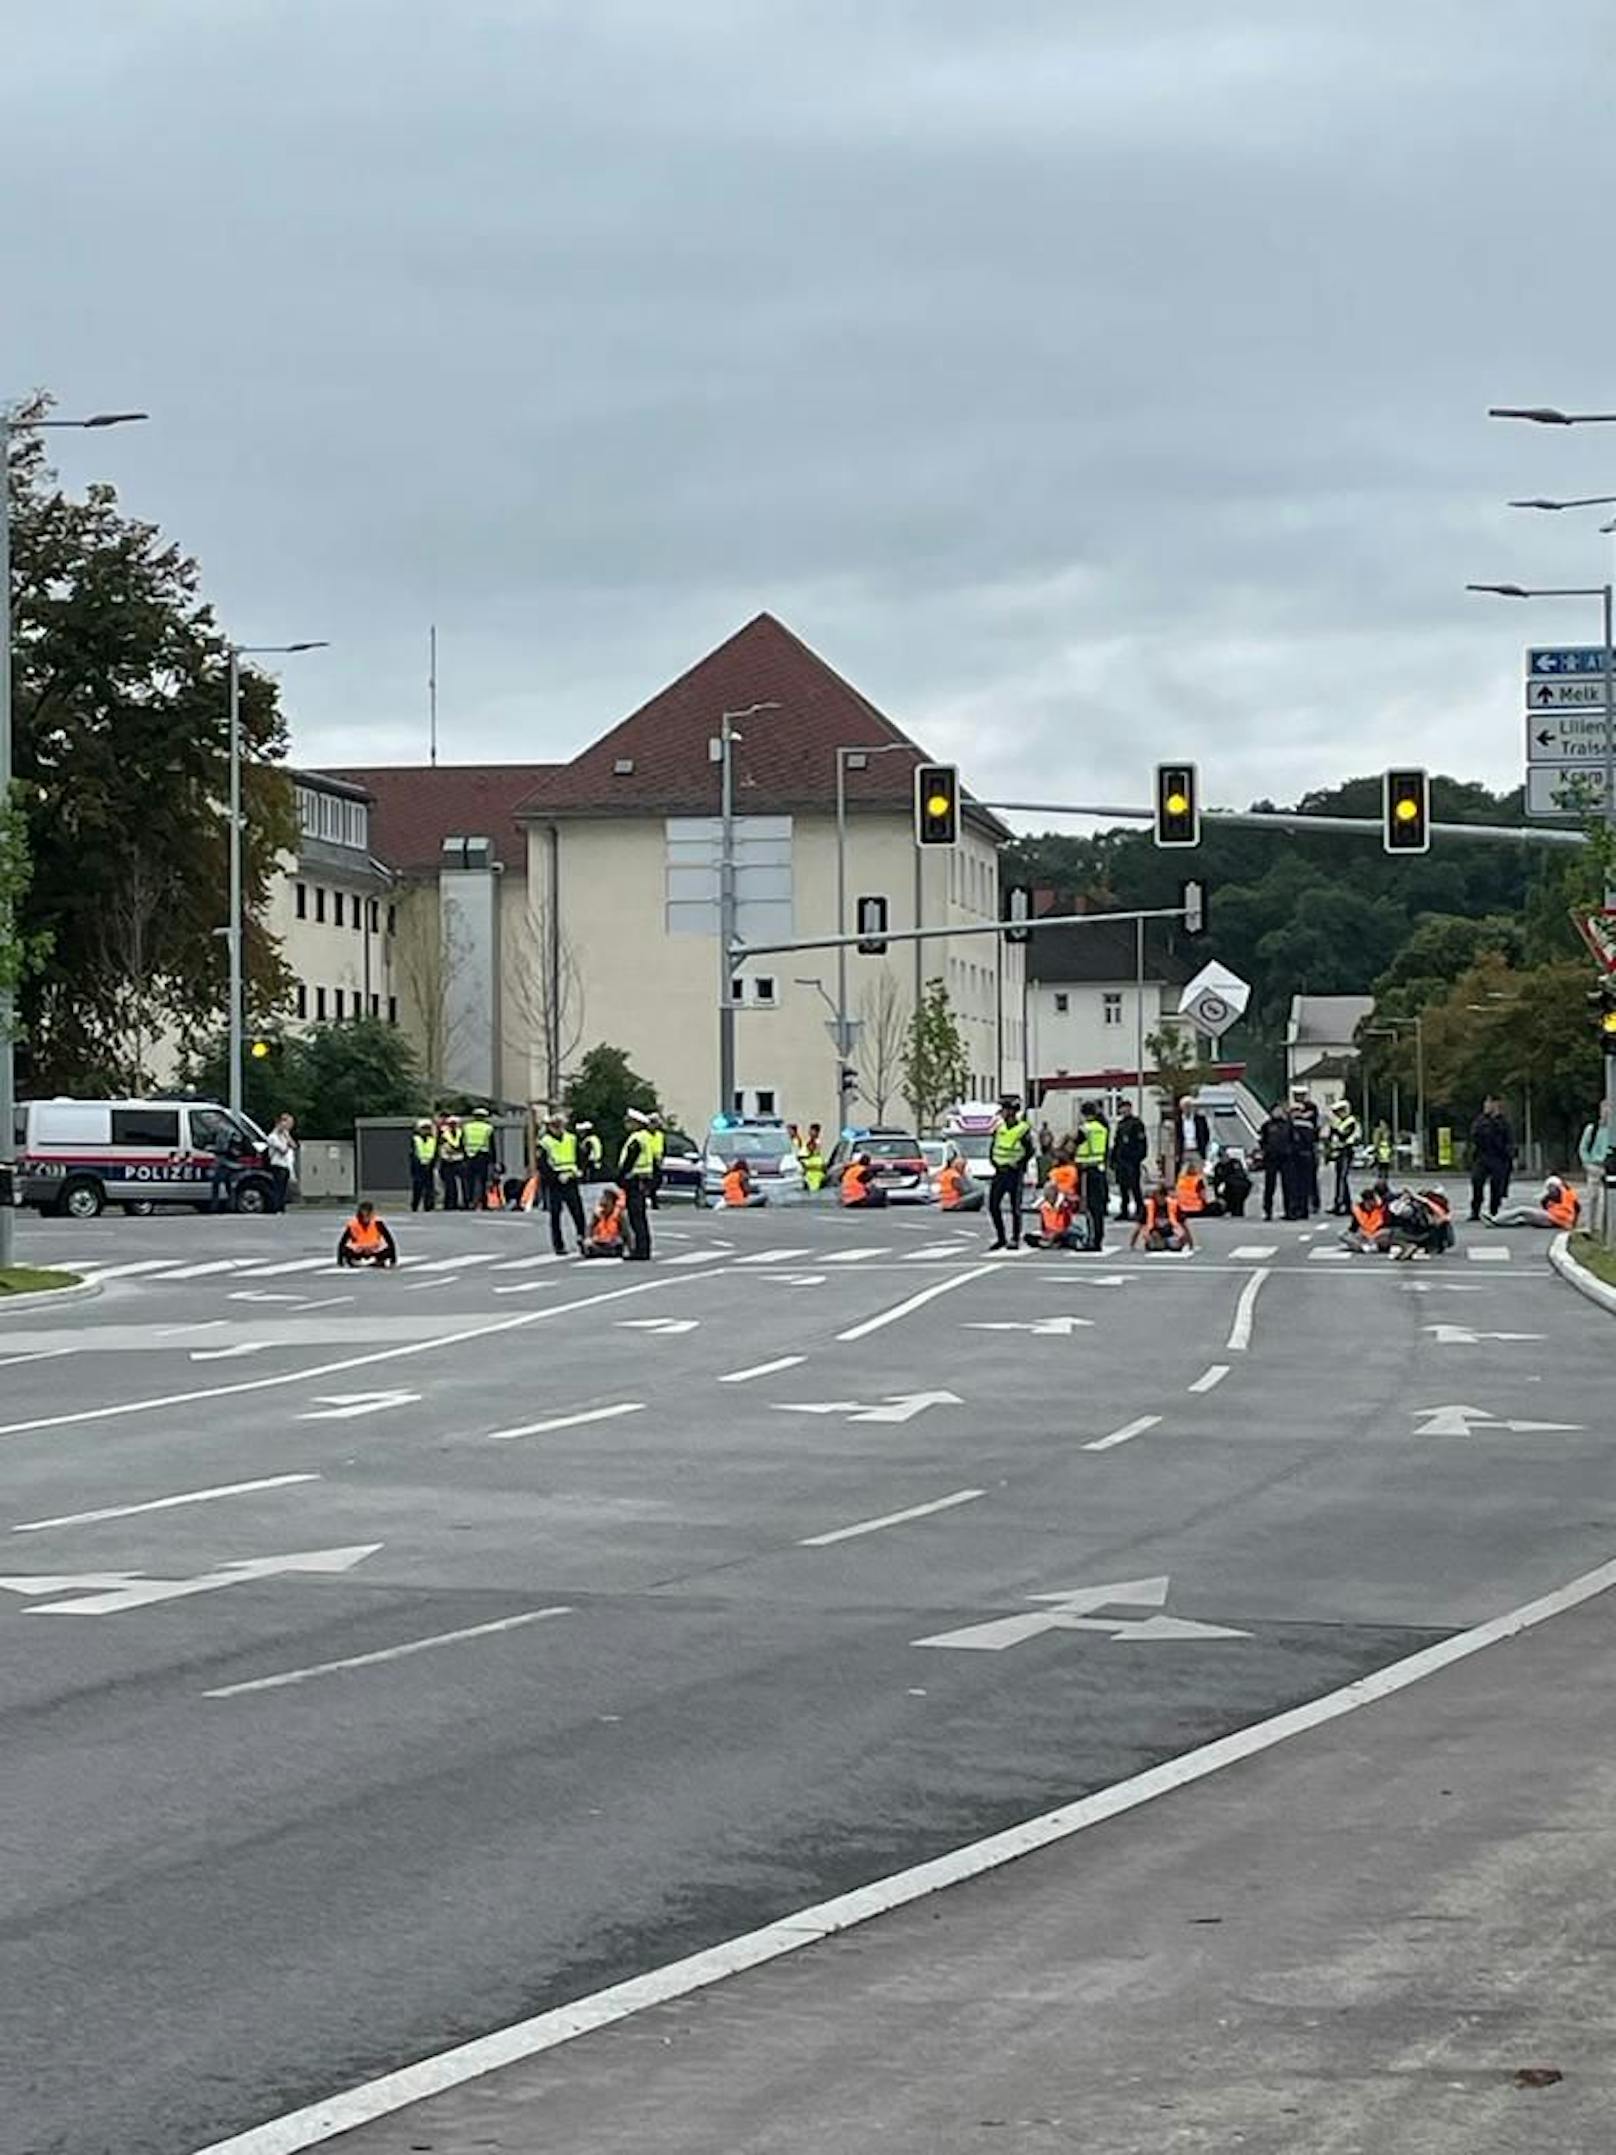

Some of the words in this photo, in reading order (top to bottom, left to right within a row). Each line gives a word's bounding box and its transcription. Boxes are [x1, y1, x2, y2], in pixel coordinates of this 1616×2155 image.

[1560, 684, 1599, 701] Melk
[1560, 719, 1616, 735] Lilien
[125, 1165, 201, 1180] POLIZEI
